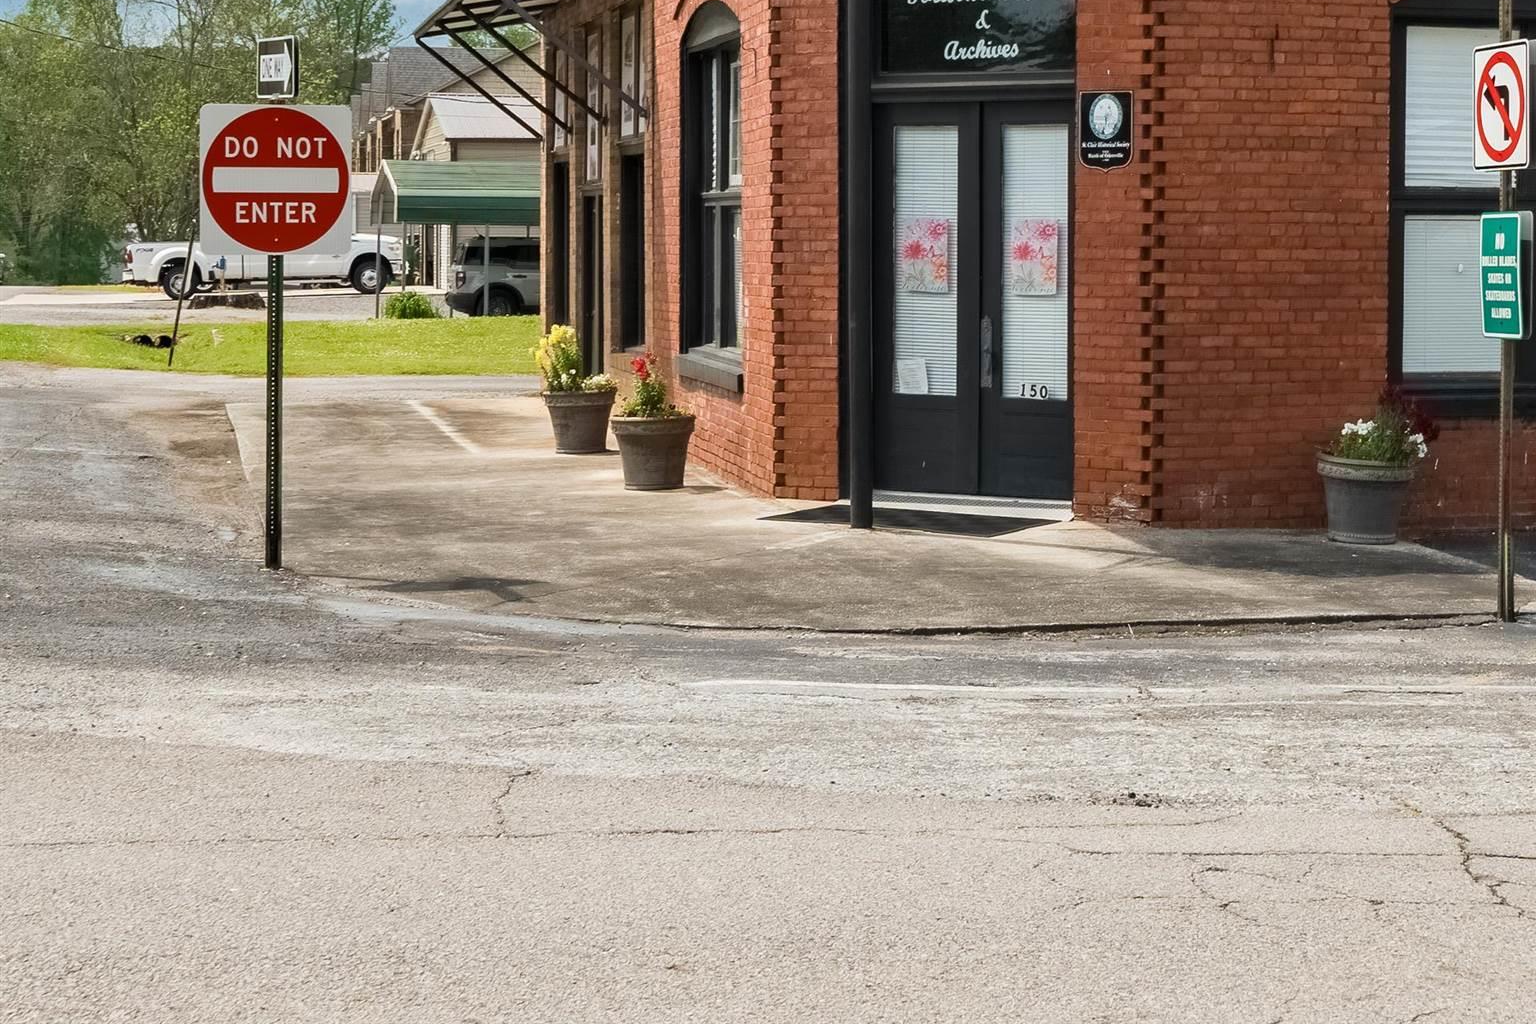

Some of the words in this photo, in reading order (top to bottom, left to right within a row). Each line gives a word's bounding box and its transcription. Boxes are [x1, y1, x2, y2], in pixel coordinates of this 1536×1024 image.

[975, 9, 991, 29] &
[943, 39, 1020, 60] Archives
[224, 136, 258, 158] DO
[277, 136, 327, 159] NOT
[235, 202, 316, 223] ENTER
[1495, 233, 1505, 250] NO
[1020, 383, 1048, 399] 150
